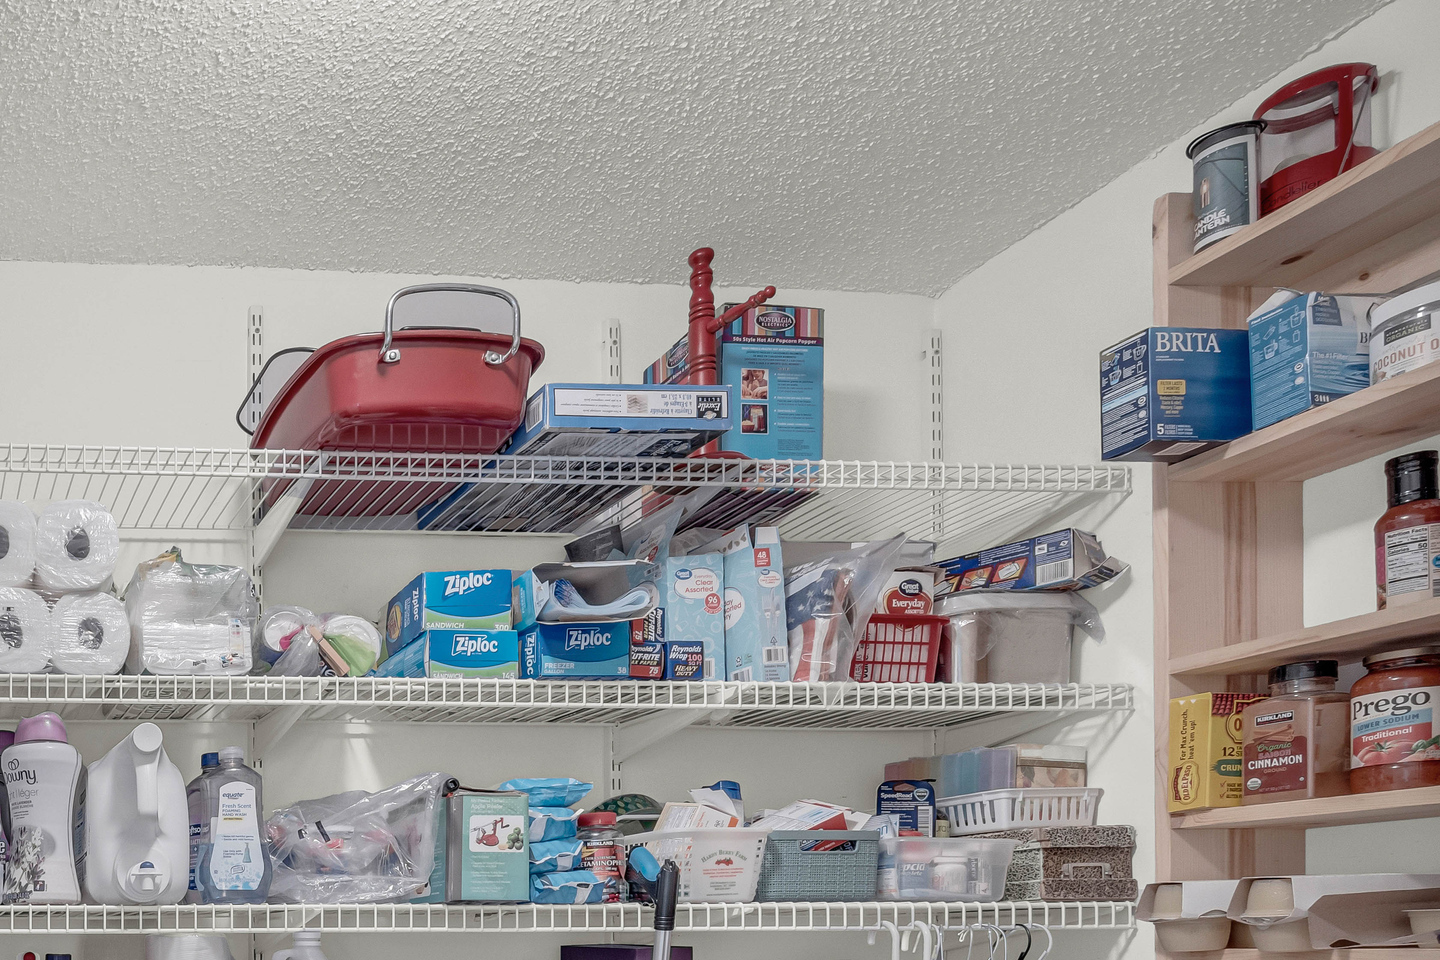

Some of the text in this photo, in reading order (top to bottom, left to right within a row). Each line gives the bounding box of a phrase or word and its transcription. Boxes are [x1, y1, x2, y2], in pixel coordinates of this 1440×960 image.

[759, 315, 793, 324] NOSTALGIA
[1385, 323, 1426, 342] ORGANIC
[1155, 332, 1221, 353] BRITA
[1373, 342, 1426, 373] COCONUT
[697, 403, 721, 411] Excelle
[1157, 424, 1164, 435] 5
[1411, 526, 1428, 534] Facts
[444, 572, 494, 596] Ziploc
[707, 596, 718, 604] 96
[892, 599, 925, 609] Everyday
[569, 630, 611, 650] Ziploc
[635, 631, 642, 640] 75
[455, 637, 498, 656] Ziploc
[672, 644, 703, 653] Reynolds
[524, 634, 535, 675] Ziploc
[670, 651, 688, 660] Wrap
[1353, 691, 1431, 720] Prego
[1180, 709, 1188, 735] Crunch,
[1257, 712, 1292, 723] KIRKLAND
[1357, 713, 1419, 731] LOWER SODIUM
[1362, 726, 1412, 742] Traditional
[1222, 746, 1235, 756] 12
[1257, 742, 1292, 752] Organic
[1248, 754, 1302, 769] CINNAMON
